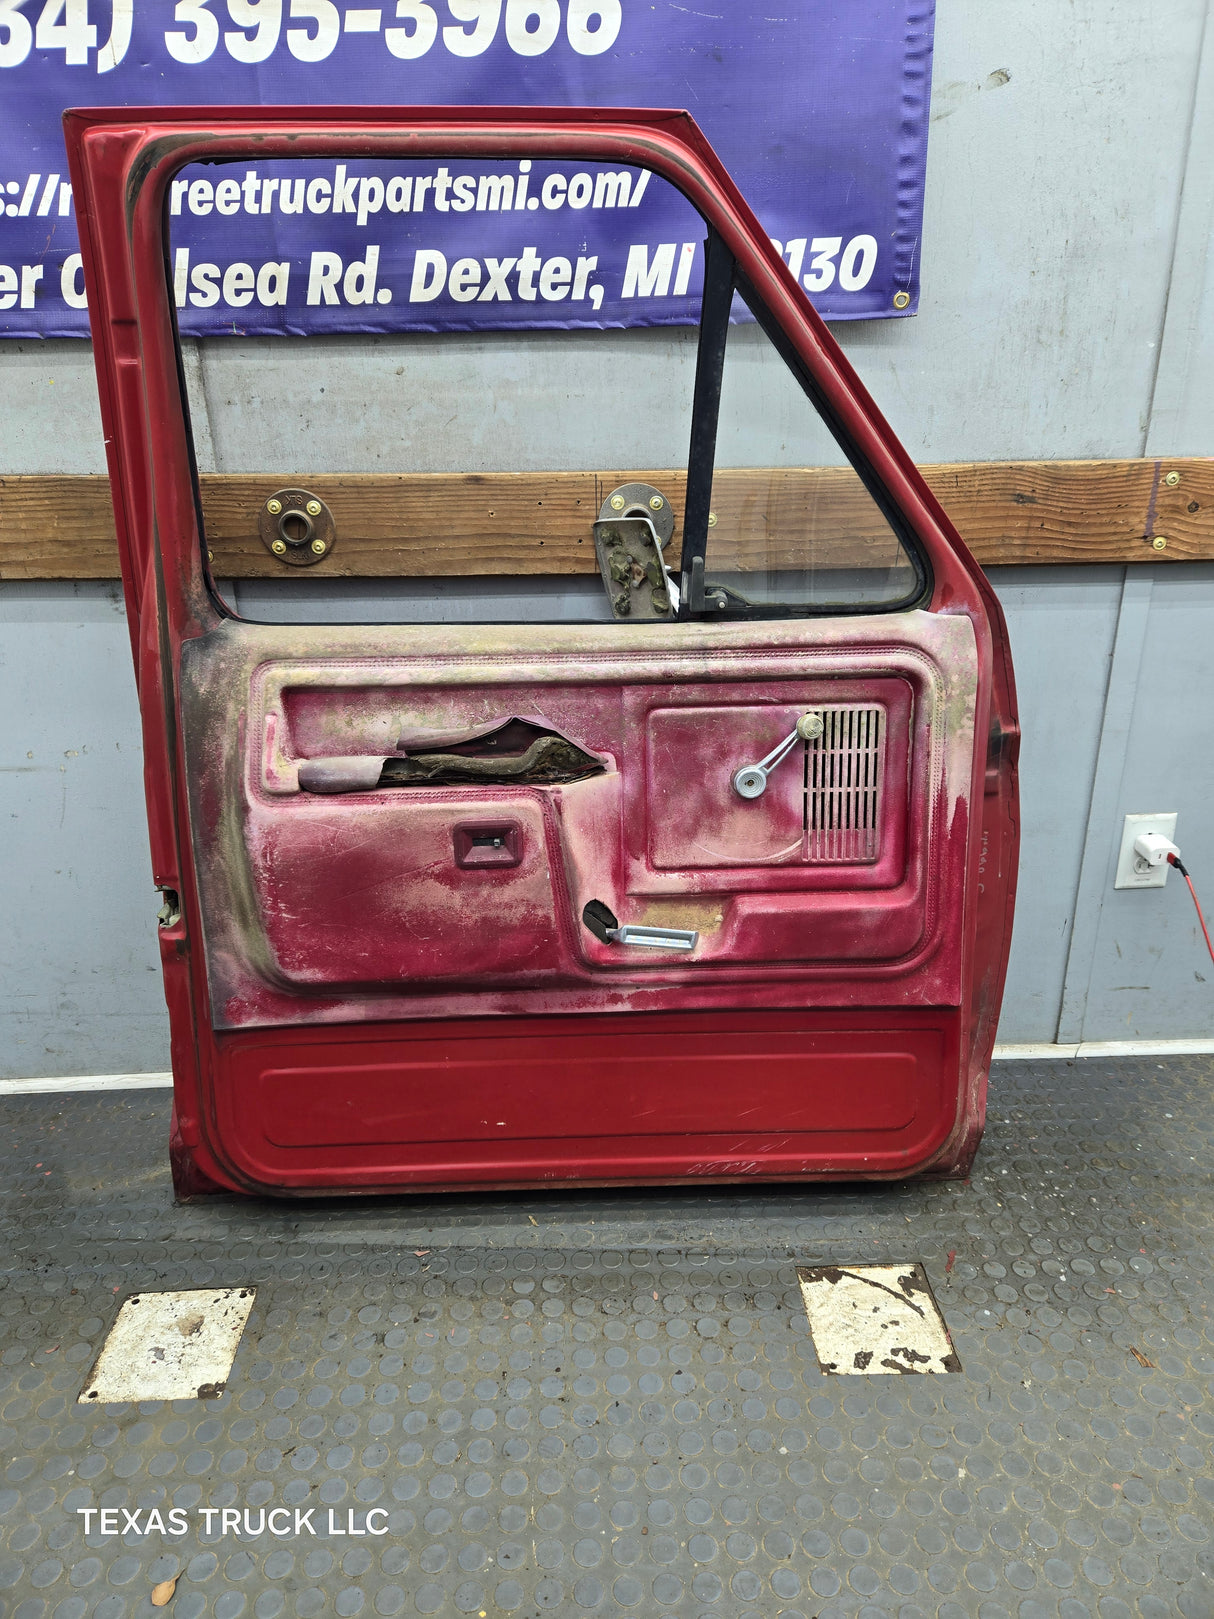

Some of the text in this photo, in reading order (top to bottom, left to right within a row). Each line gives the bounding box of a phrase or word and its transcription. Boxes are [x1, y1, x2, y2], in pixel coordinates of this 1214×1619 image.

[164, 0, 622, 63] 395-3966
[306, 245, 392, 306] Rd.
[409, 246, 604, 310] Dexter,
[621, 243, 696, 298] MI
